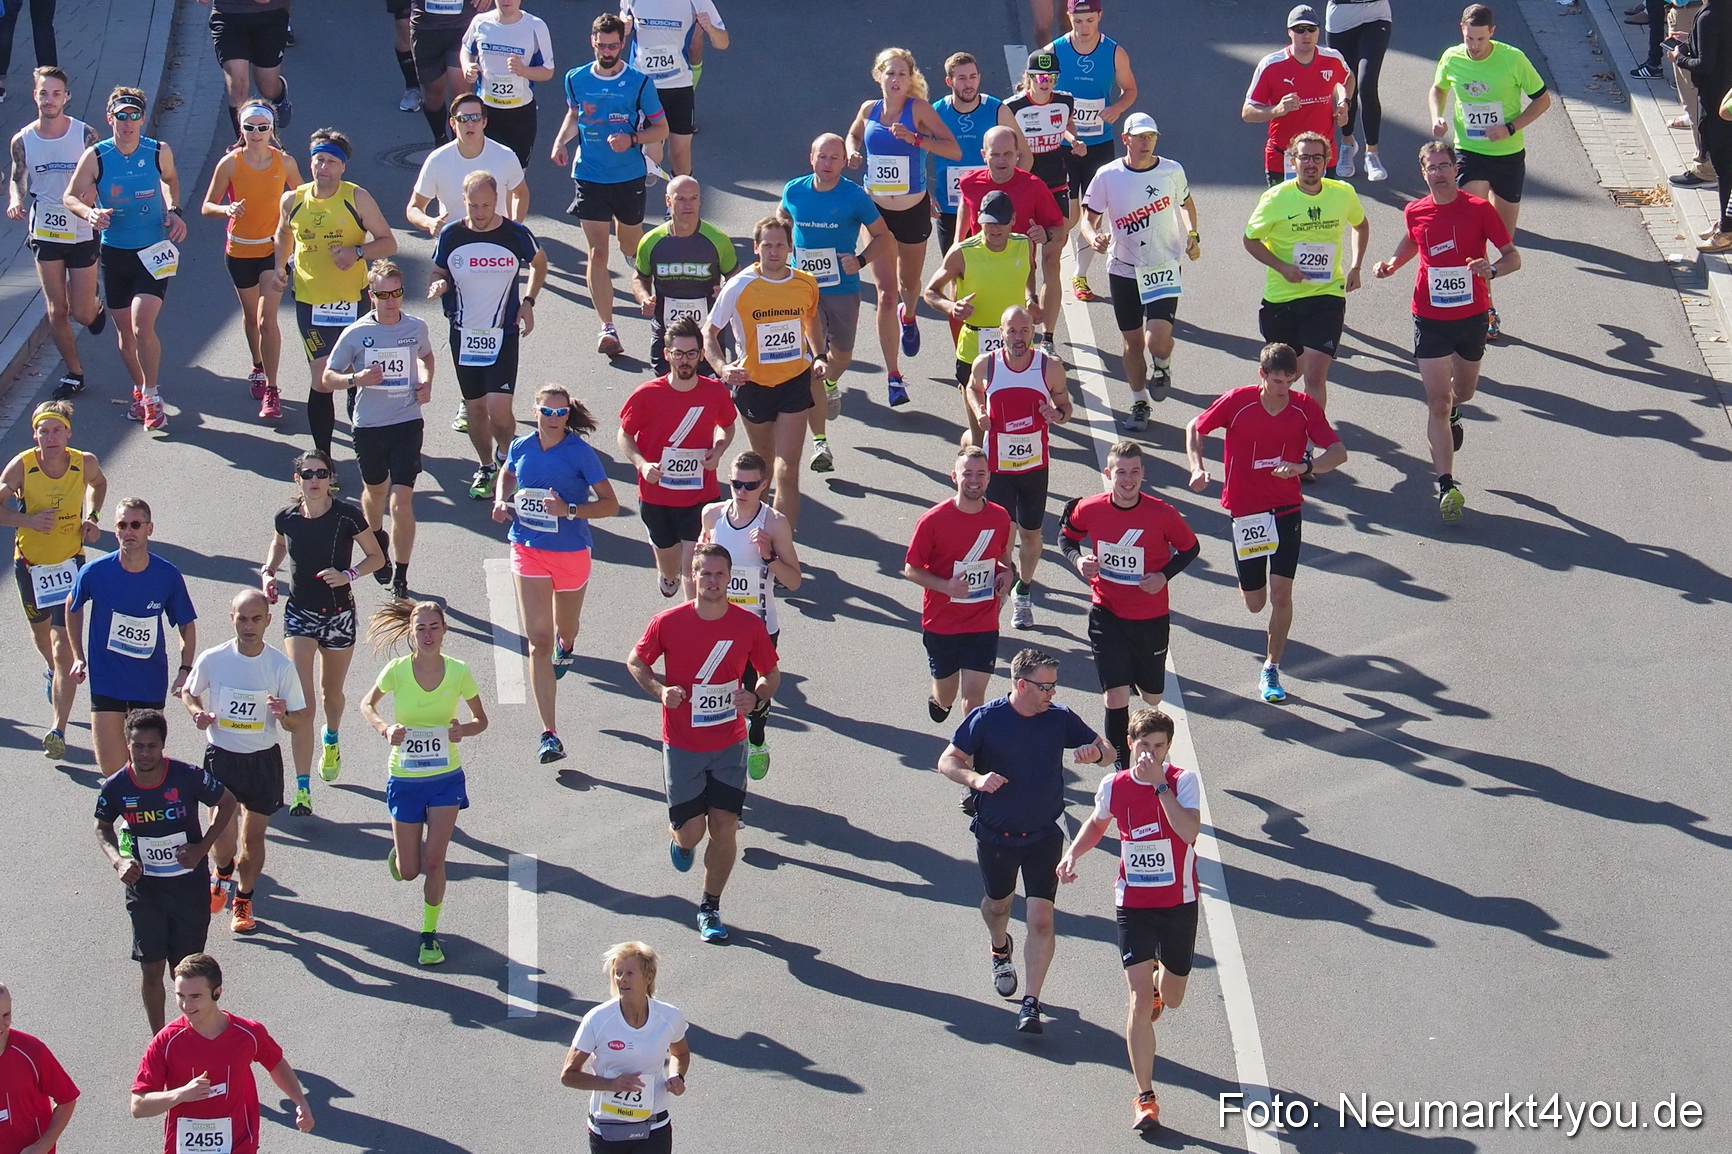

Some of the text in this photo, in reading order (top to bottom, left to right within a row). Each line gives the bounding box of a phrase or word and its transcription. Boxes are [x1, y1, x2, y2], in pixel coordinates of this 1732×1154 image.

[646, 55, 674, 68] 2784
[492, 83, 513, 95] 232
[1073, 110, 1099, 121] 2077
[1469, 112, 1498, 124] 2175
[876, 166, 899, 179] 350
[45, 212, 67, 227] 236
[1115, 195, 1171, 230] FINISHER
[796, 221, 839, 229] www.hasit.de
[1124, 214, 1151, 235] 2017
[153, 250, 174, 264] 344
[469, 257, 514, 267] BOSCH
[1299, 253, 1328, 266] 2296
[656, 263, 712, 277] BOCK
[801, 258, 831, 272] 2609
[1142, 269, 1174, 287] 3072
[1434, 277, 1466, 291] 2465
[752, 307, 800, 320] Continental
[466, 337, 496, 350] 2598
[764, 331, 796, 347] 2246
[1008, 443, 1033, 456] 264
[667, 459, 698, 473] 2620
[521, 498, 546, 512] 255
[1241, 525, 1267, 541] 262
[1103, 553, 1137, 568] 2619
[39, 571, 72, 589] 3119
[726, 577, 748, 591] 00
[117, 624, 150, 642] 2635
[699, 692, 732, 709] 2614
[229, 701, 257, 716] 247
[231, 722, 252, 730] Jochen
[406, 738, 441, 754] 2616
[123, 808, 187, 824] MENSCH
[1130, 853, 1165, 868] 2459
[613, 1089, 642, 1102] 273
[617, 1108, 634, 1116] Heidi
[185, 1132, 224, 1147] 2455
